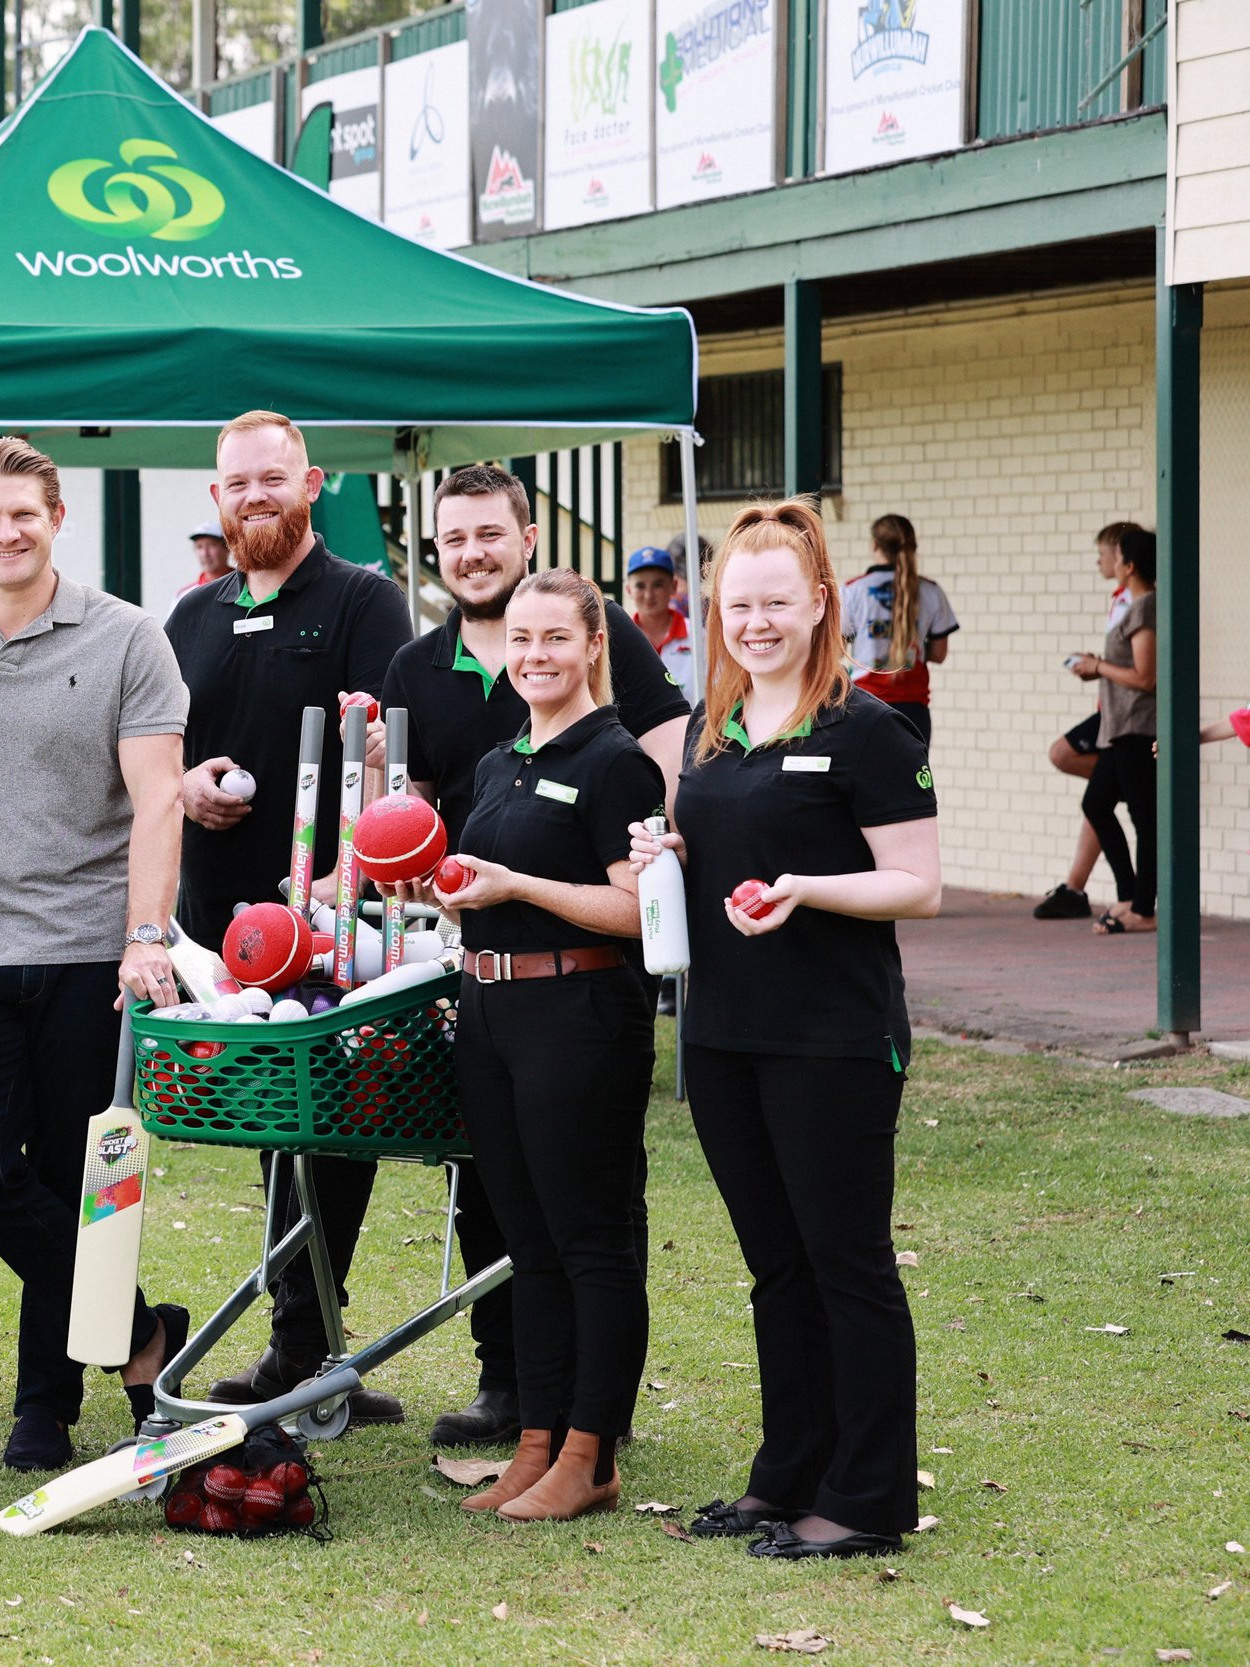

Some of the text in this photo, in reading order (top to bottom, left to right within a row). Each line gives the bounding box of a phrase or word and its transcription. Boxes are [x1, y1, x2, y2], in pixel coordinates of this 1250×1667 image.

[15, 245, 303, 279] Woolworths
[337, 840, 353, 982] playcricket.com.au
[97, 1144, 131, 1155] BLAST
